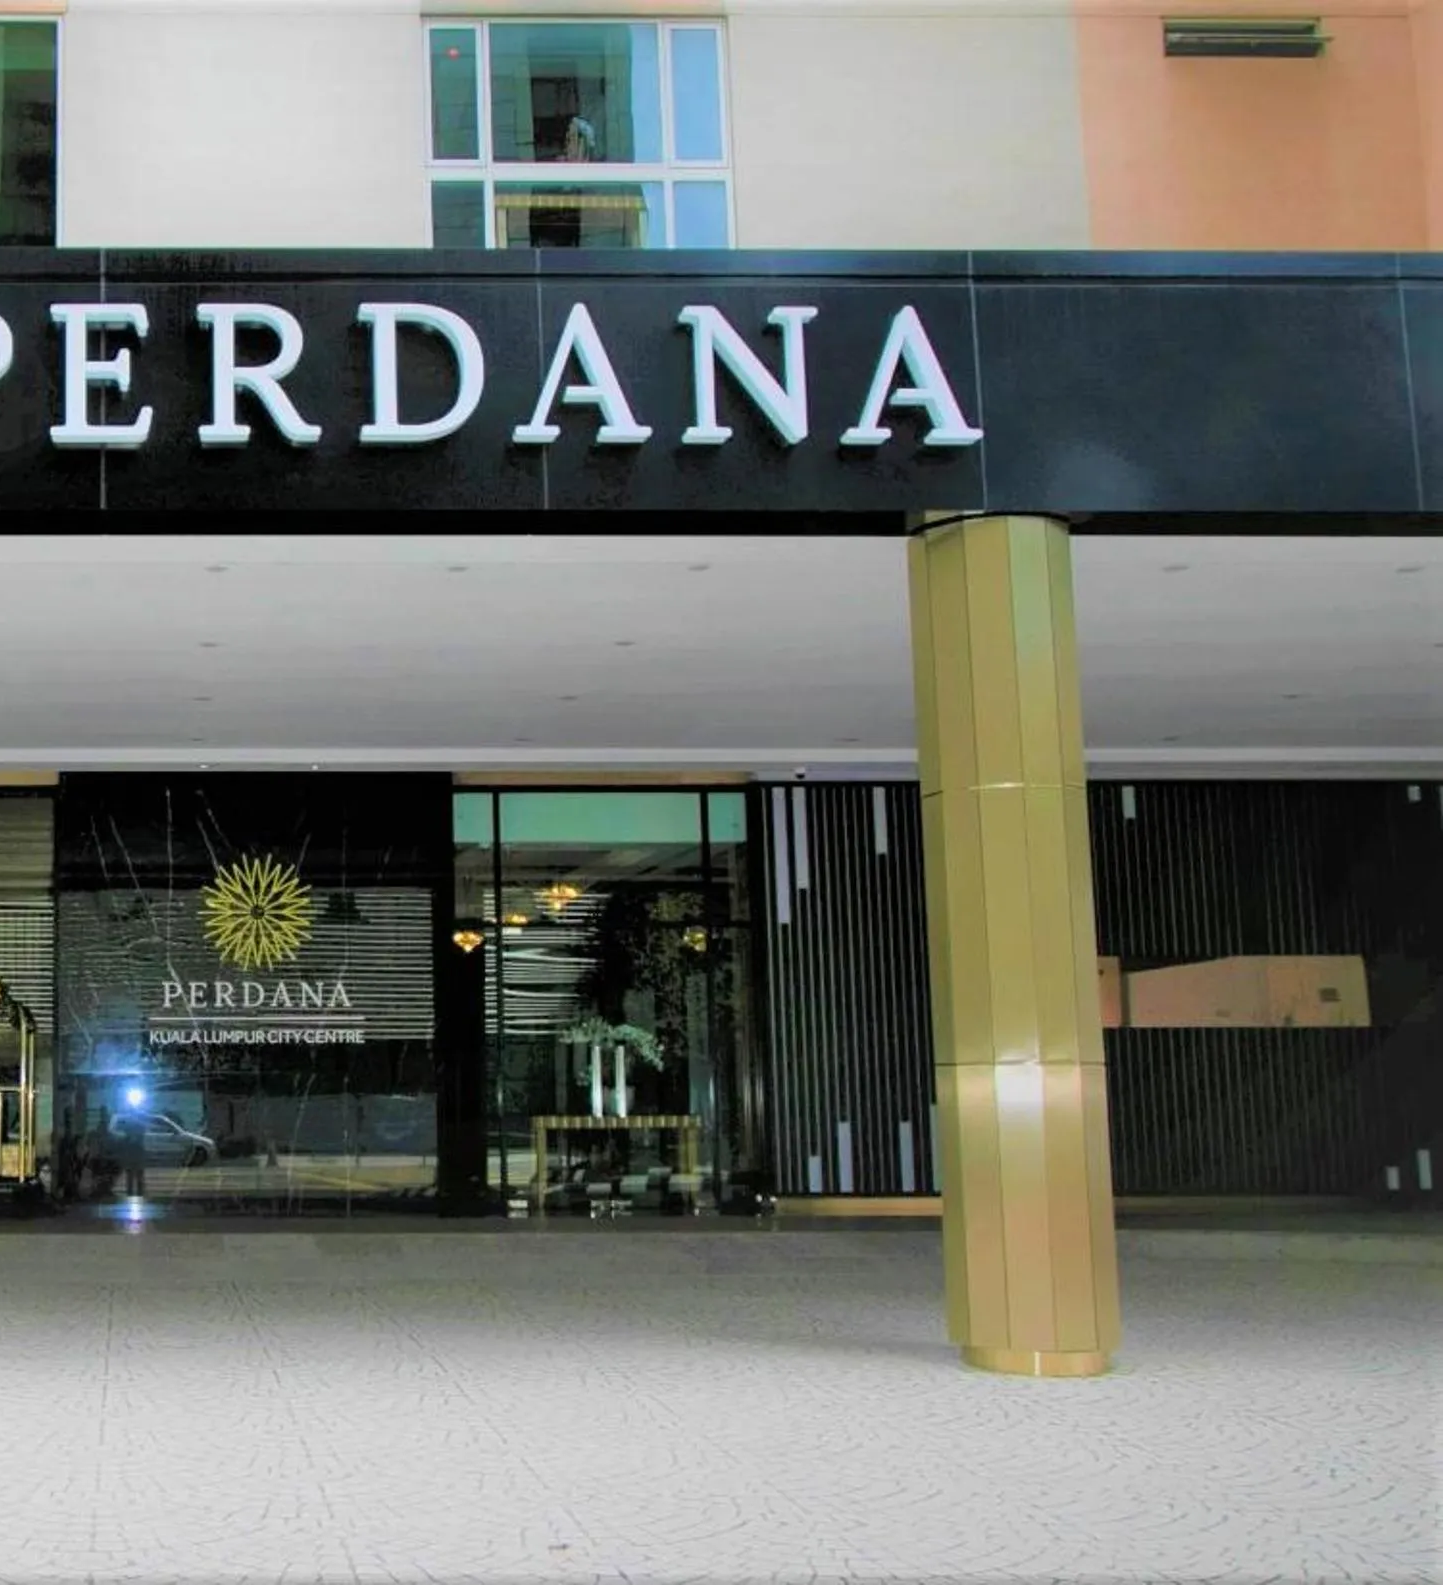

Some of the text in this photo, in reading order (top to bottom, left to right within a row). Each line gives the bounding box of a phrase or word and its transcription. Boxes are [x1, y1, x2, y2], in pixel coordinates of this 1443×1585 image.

[161, 981, 353, 1008] PERDANA
[149, 1029, 365, 1044] KUALA LUMPUR CITY CENTRE
